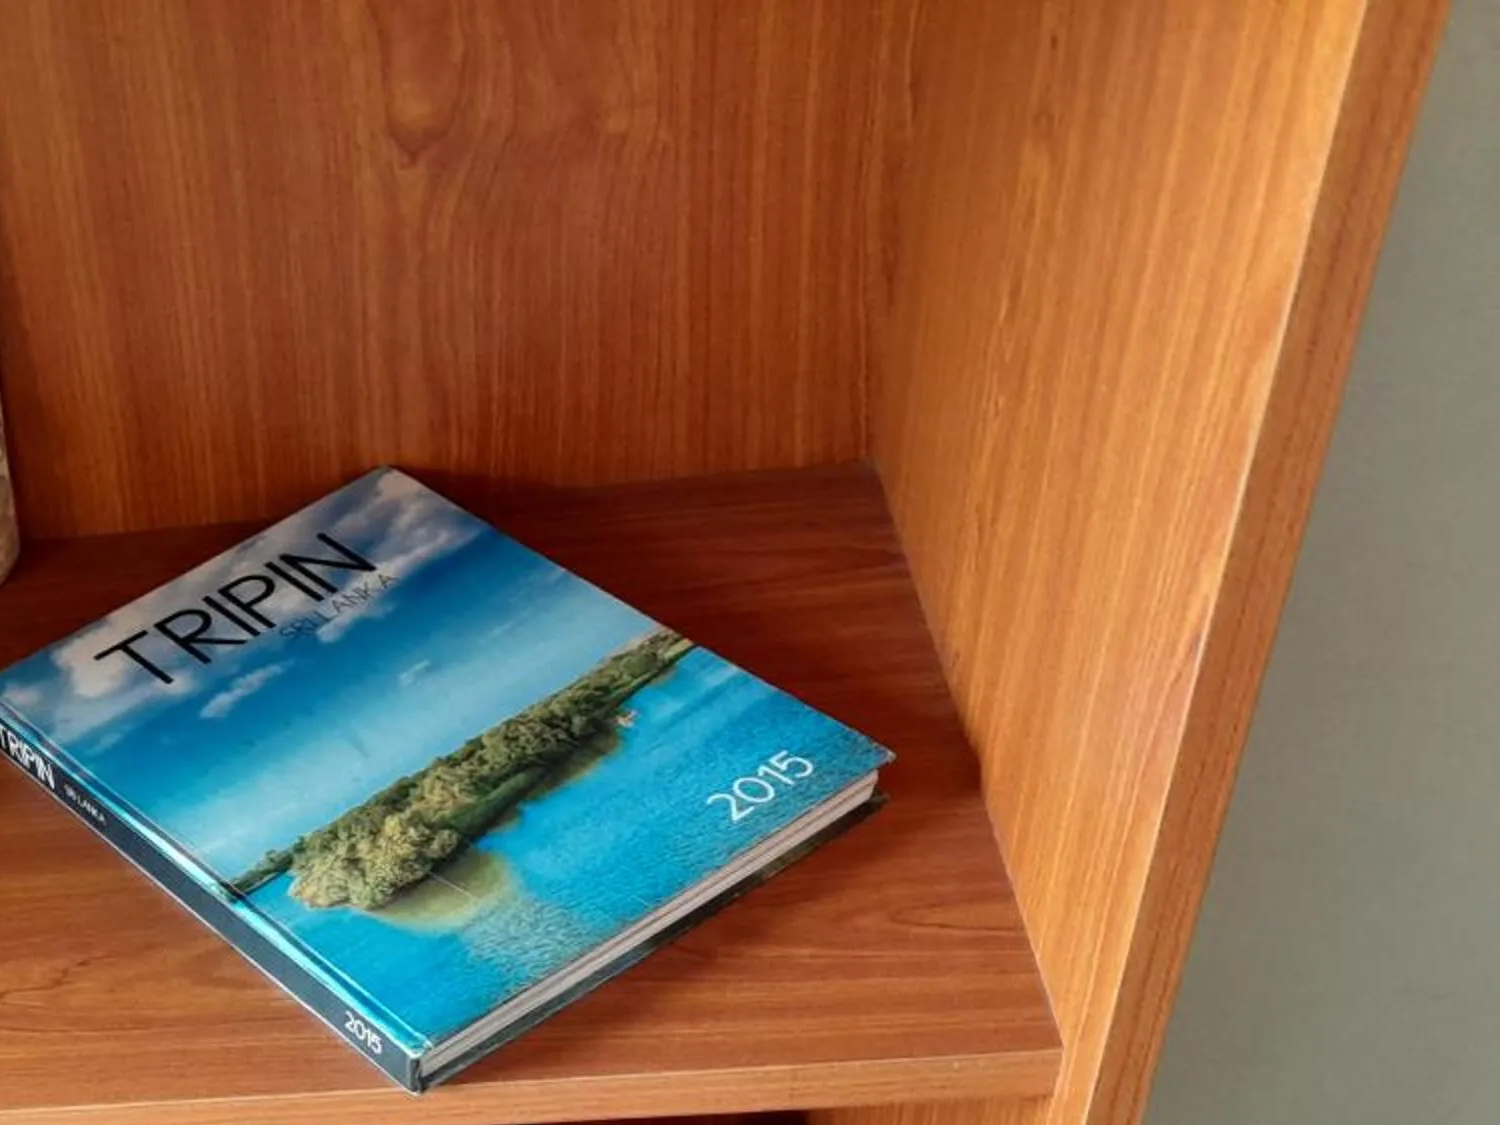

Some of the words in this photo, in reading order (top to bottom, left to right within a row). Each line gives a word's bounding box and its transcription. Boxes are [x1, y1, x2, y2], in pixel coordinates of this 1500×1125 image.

[94, 533, 377, 685] TRIPIN
[706, 748, 815, 824] 2015
[343, 1009, 384, 1055] 2015
